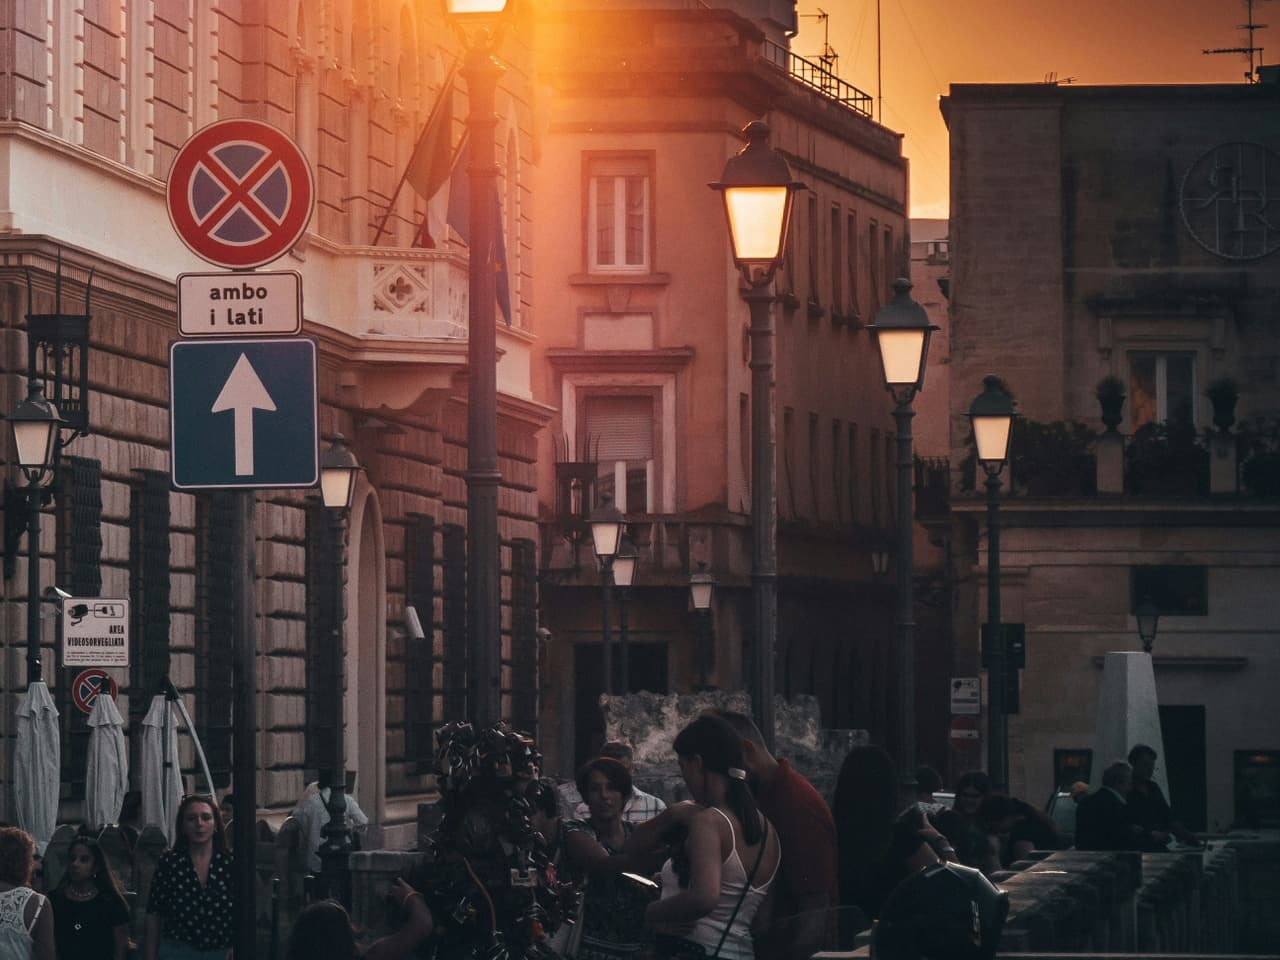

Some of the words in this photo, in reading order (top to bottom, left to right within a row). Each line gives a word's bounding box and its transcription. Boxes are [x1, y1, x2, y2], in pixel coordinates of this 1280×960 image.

[210, 282, 267, 300] ambo
[210, 308, 215, 325] i
[227, 307, 263, 325] lati
[109, 625, 124, 634] AREA
[68, 637, 124, 646] VIDEOSORVEGLIATA
